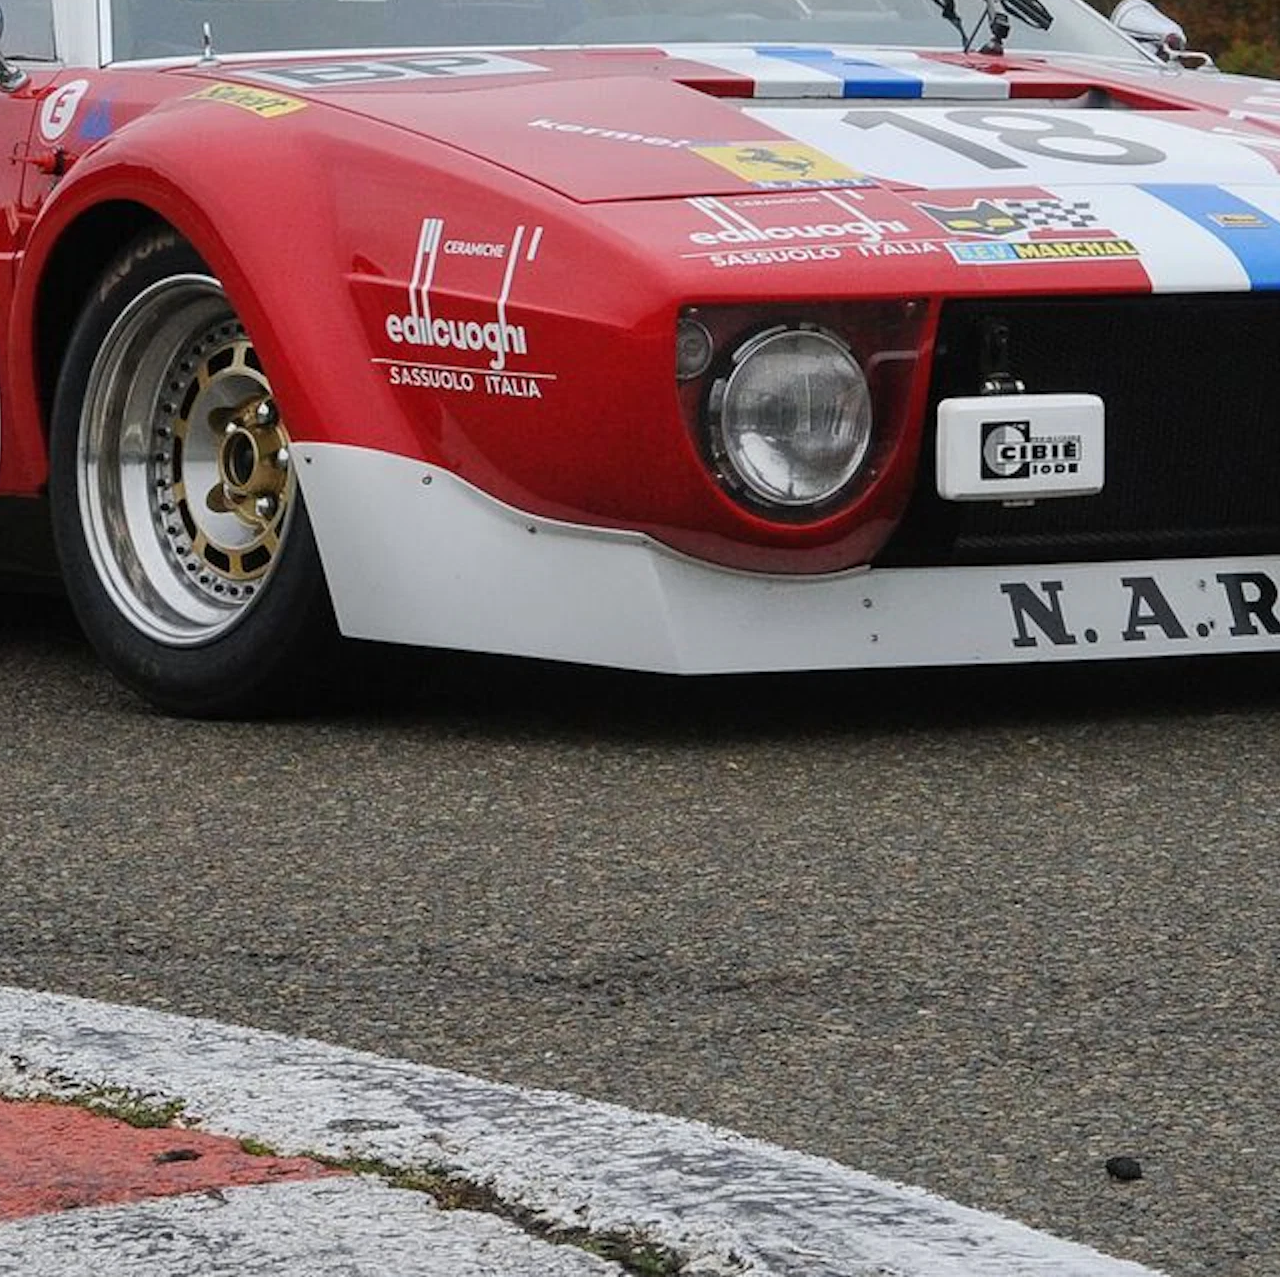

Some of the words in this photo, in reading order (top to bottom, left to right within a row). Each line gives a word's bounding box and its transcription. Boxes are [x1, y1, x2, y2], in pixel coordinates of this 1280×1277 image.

[256, 57, 488, 83] BP
[841, 110, 1168, 170] 18
[444, 239, 507, 258] CERAMICHE
[710, 245, 841, 268] SASSUOLO
[858, 241, 940, 258] ITALIA
[1014, 240, 1138, 259] MARCHAL
[391, 366, 475, 391] SASSUOLO
[485, 375, 542, 399] ITALIA
